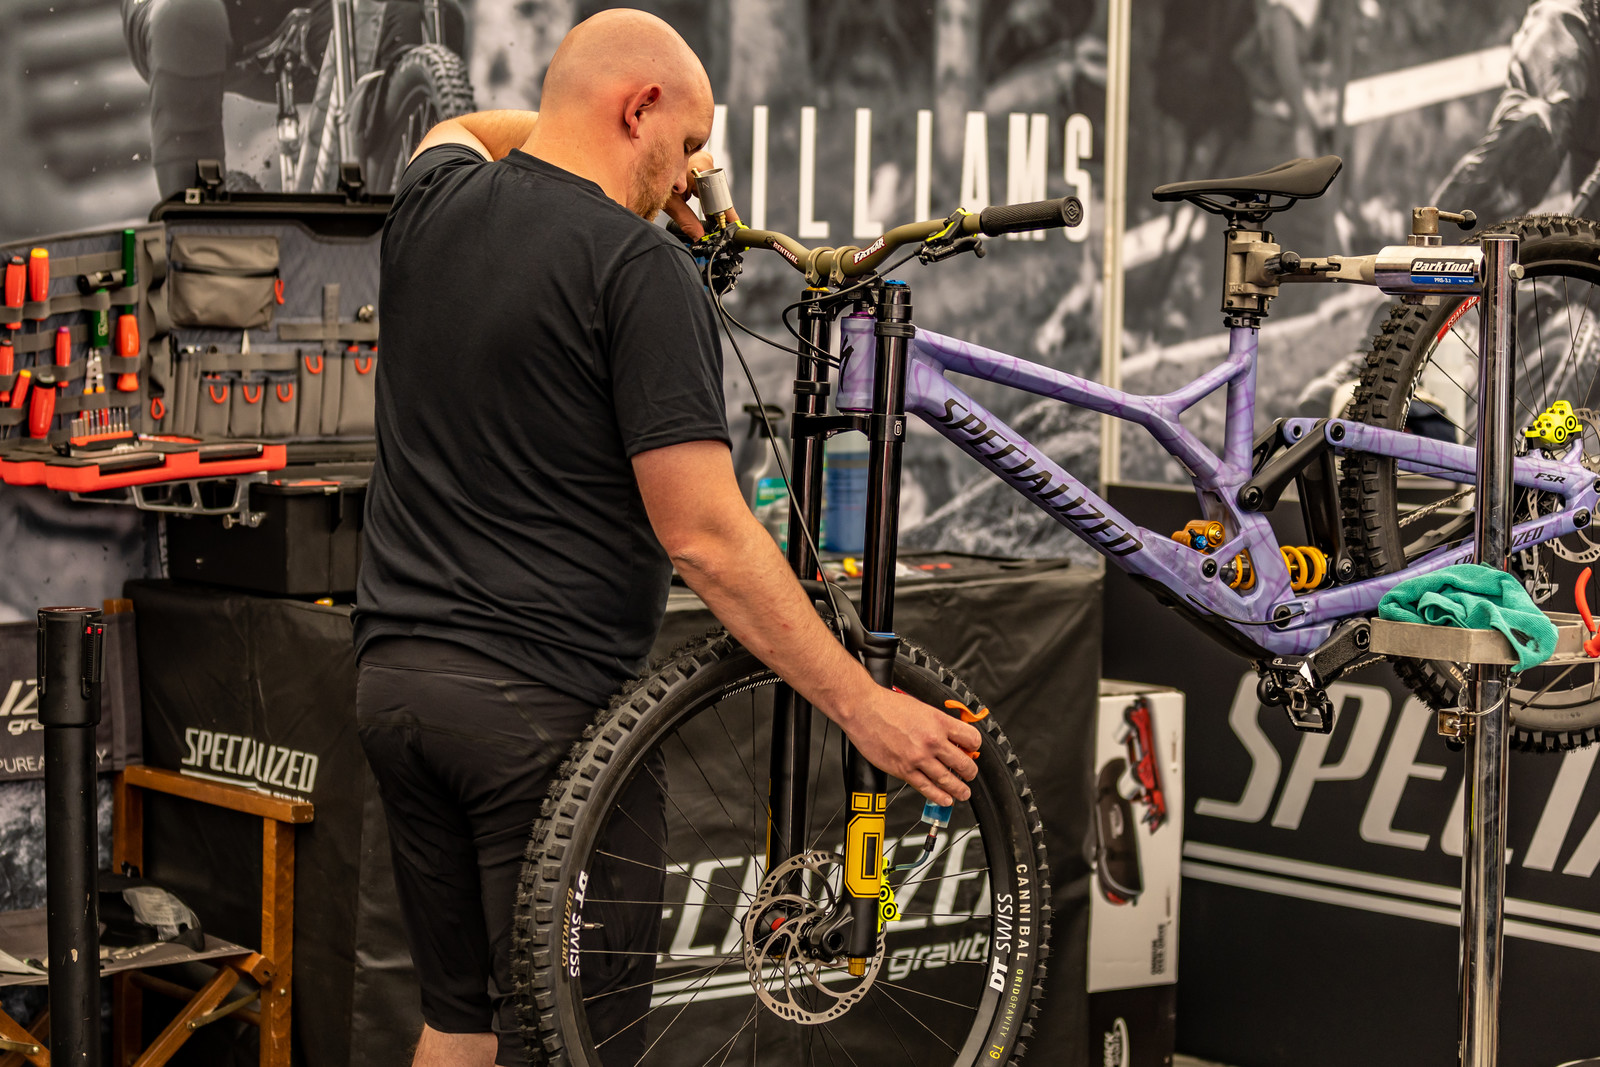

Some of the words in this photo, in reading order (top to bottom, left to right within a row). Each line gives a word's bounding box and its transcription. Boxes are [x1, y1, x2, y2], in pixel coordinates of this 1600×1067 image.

[854, 237, 885, 264] FATBAR
[925, 398, 1143, 556] SPECIALIZED
[1534, 472, 1566, 484] FSR
[181, 727, 318, 793] SPECIALIZED
[574, 870, 589, 909] DT
[1016, 863, 1031, 961] CANNIBAL
[561, 887, 575, 968] SPECIALIZED
[570, 912, 581, 978] SWISS
[996, 893, 1013, 953] SWISS
[989, 956, 1008, 993] DT
[989, 1043, 1005, 1060] T9
